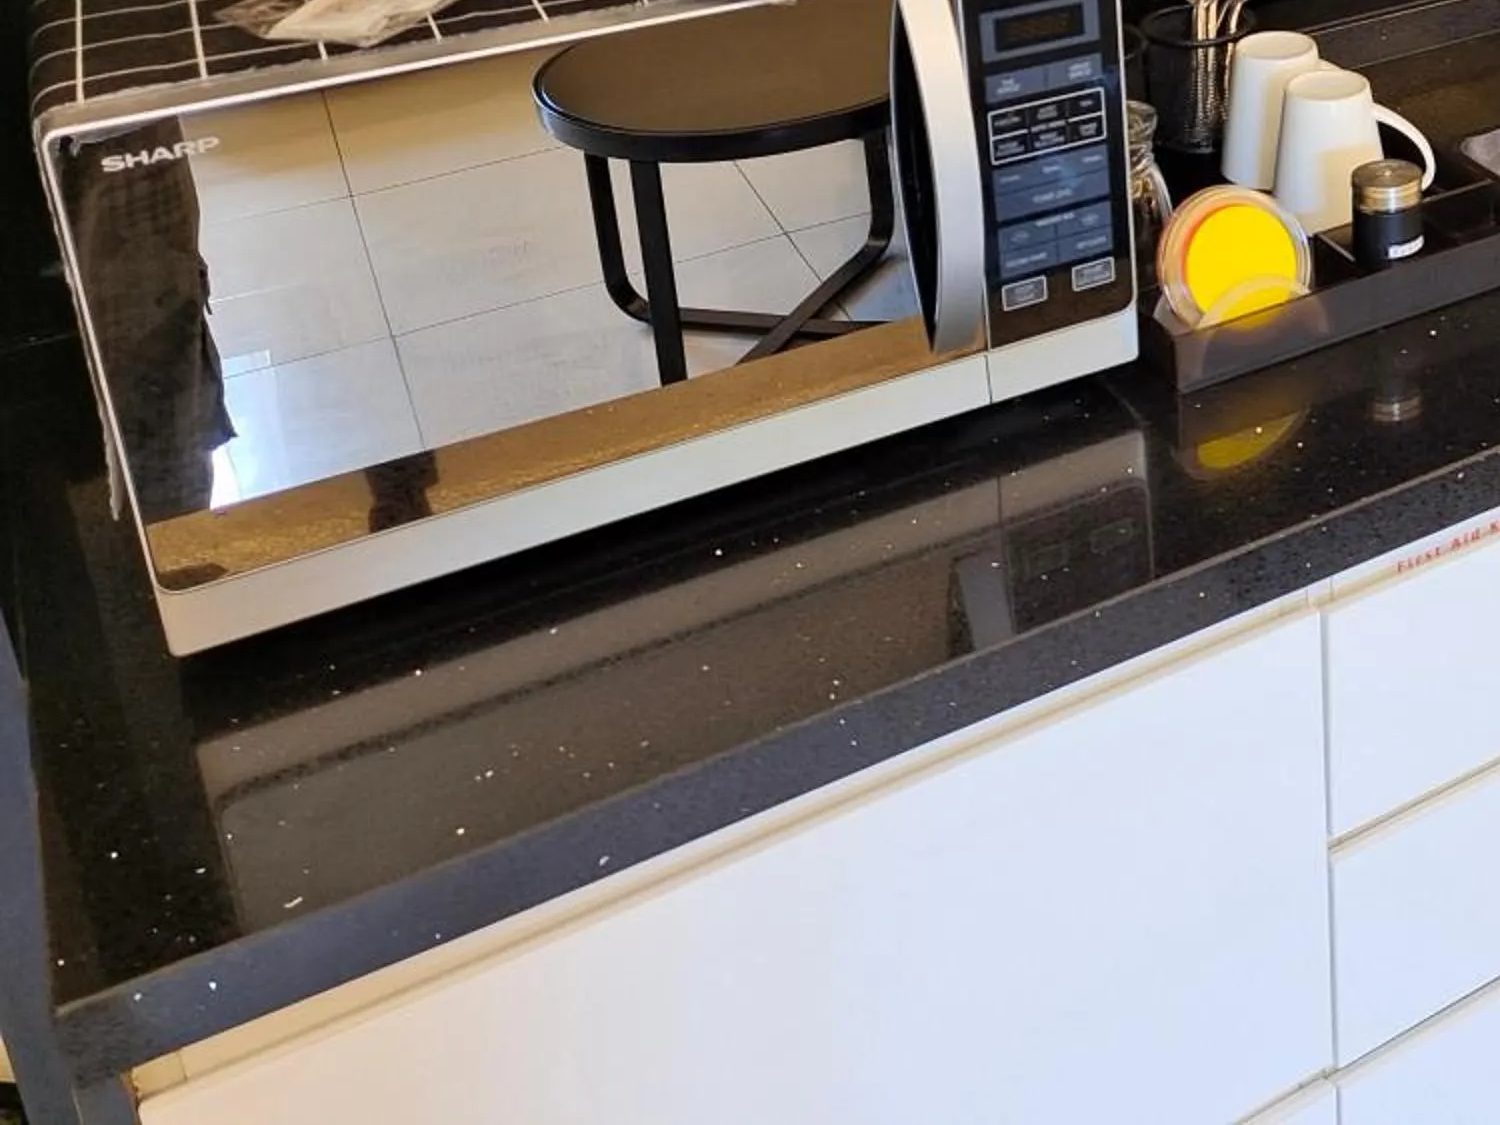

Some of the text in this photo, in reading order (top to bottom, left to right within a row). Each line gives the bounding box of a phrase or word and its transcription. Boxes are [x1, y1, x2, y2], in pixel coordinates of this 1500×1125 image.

[101, 136, 220, 172] SHARP
[1397, 546, 1440, 572] First
[1450, 527, 1481, 549] Aid
